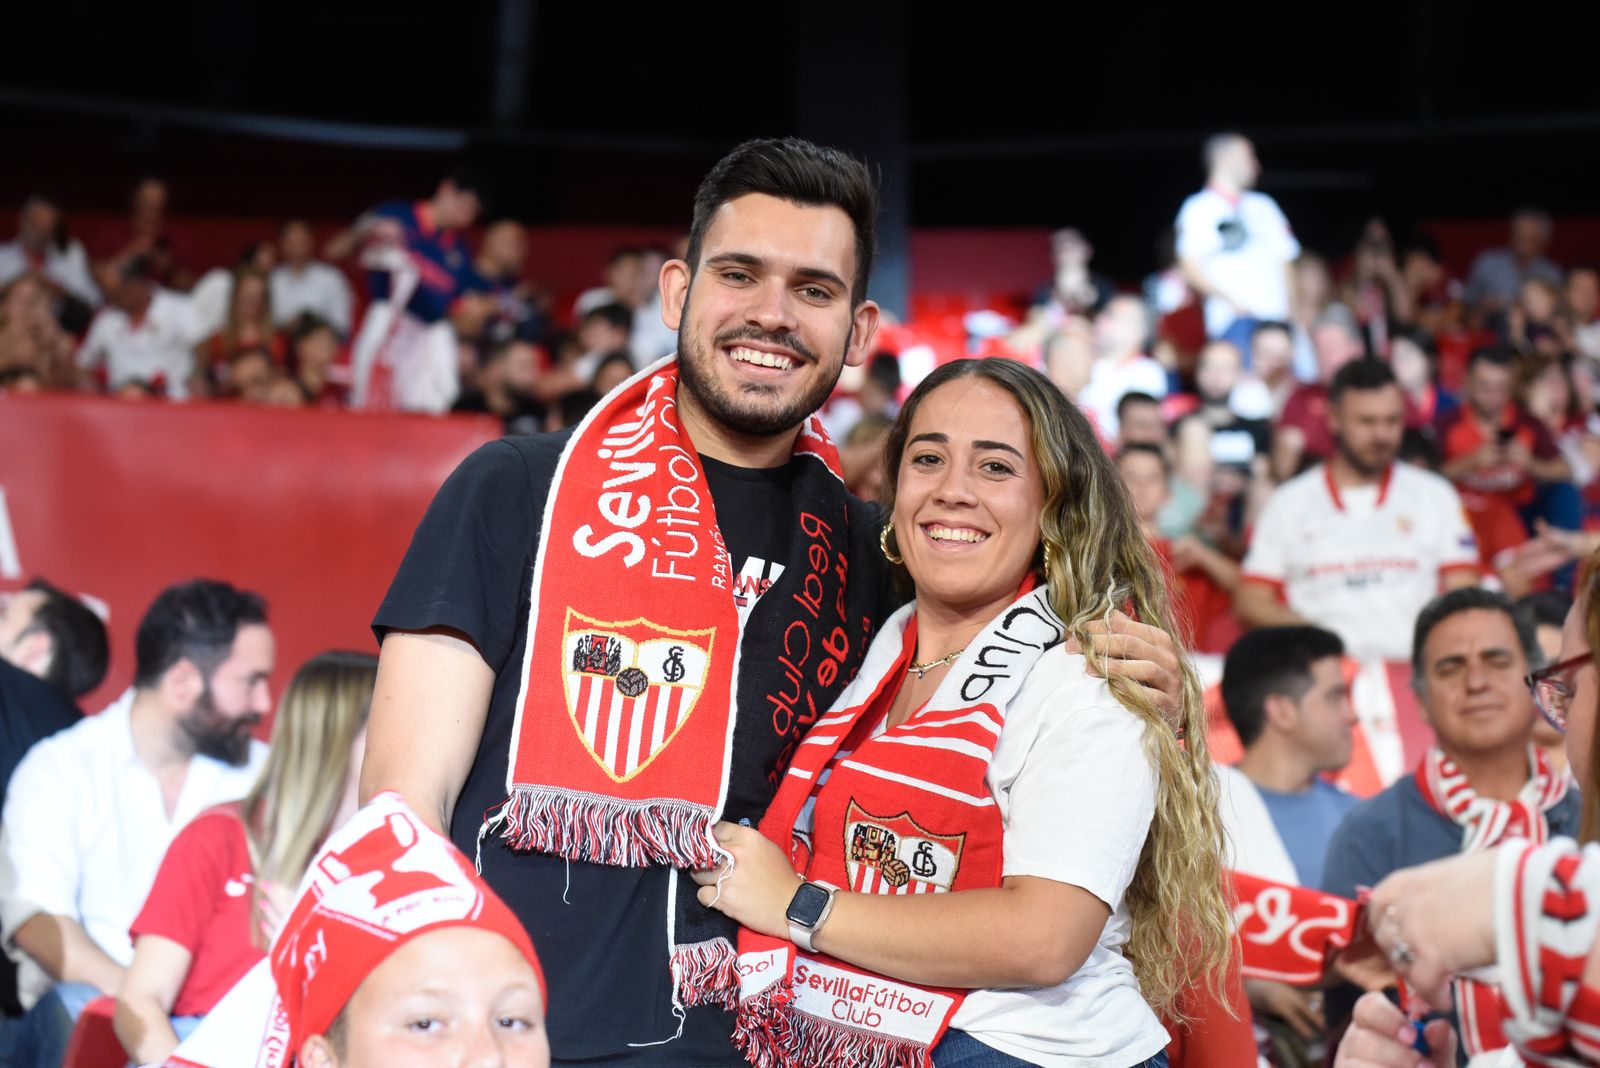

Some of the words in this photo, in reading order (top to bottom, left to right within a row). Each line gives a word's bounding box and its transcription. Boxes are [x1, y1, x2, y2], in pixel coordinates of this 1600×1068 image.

[652, 445, 700, 581] Fútbol
[709, 524, 728, 590] RAMÓ
[960, 607, 1062, 702] Club
[831, 999, 882, 1028] Club
